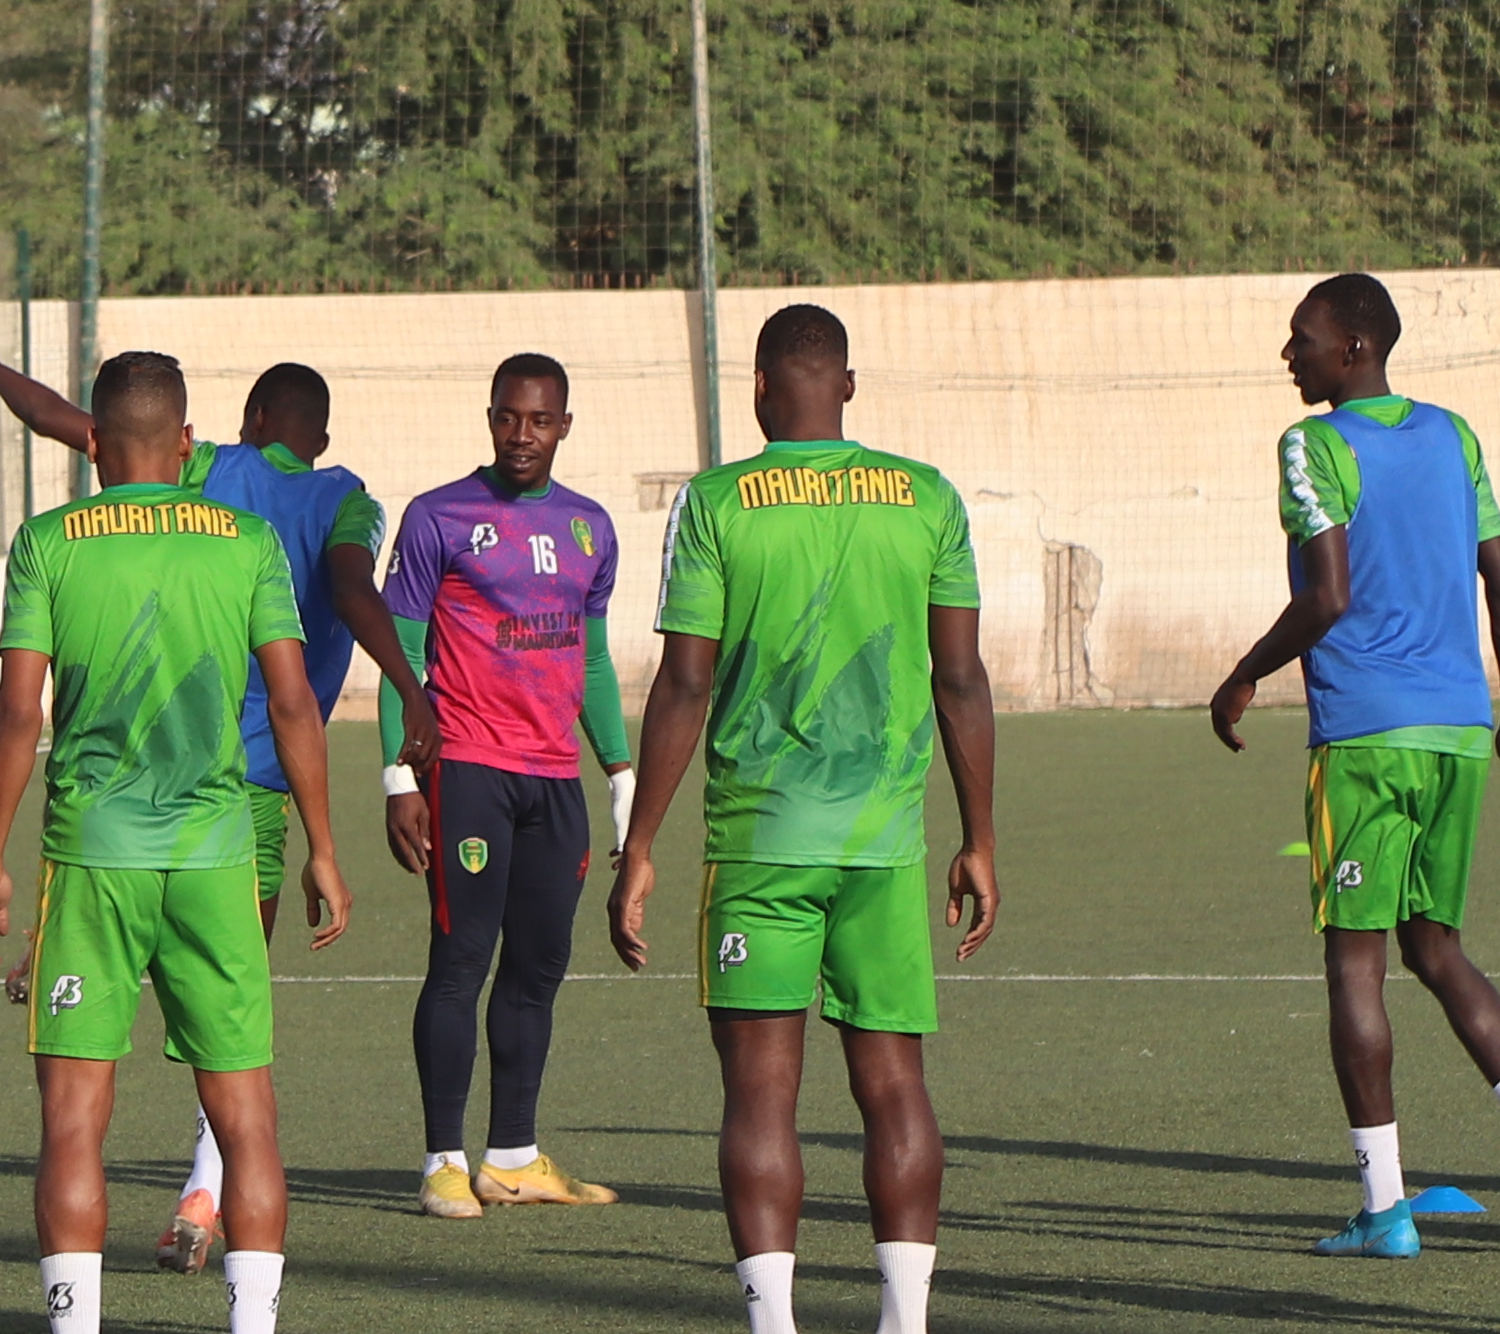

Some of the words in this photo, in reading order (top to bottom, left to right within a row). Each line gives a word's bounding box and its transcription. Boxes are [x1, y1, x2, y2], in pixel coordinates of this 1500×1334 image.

[737, 466, 916, 510] MAURITANIE
[63, 502, 239, 541] MAURITANIE
[528, 534, 558, 574] 16
